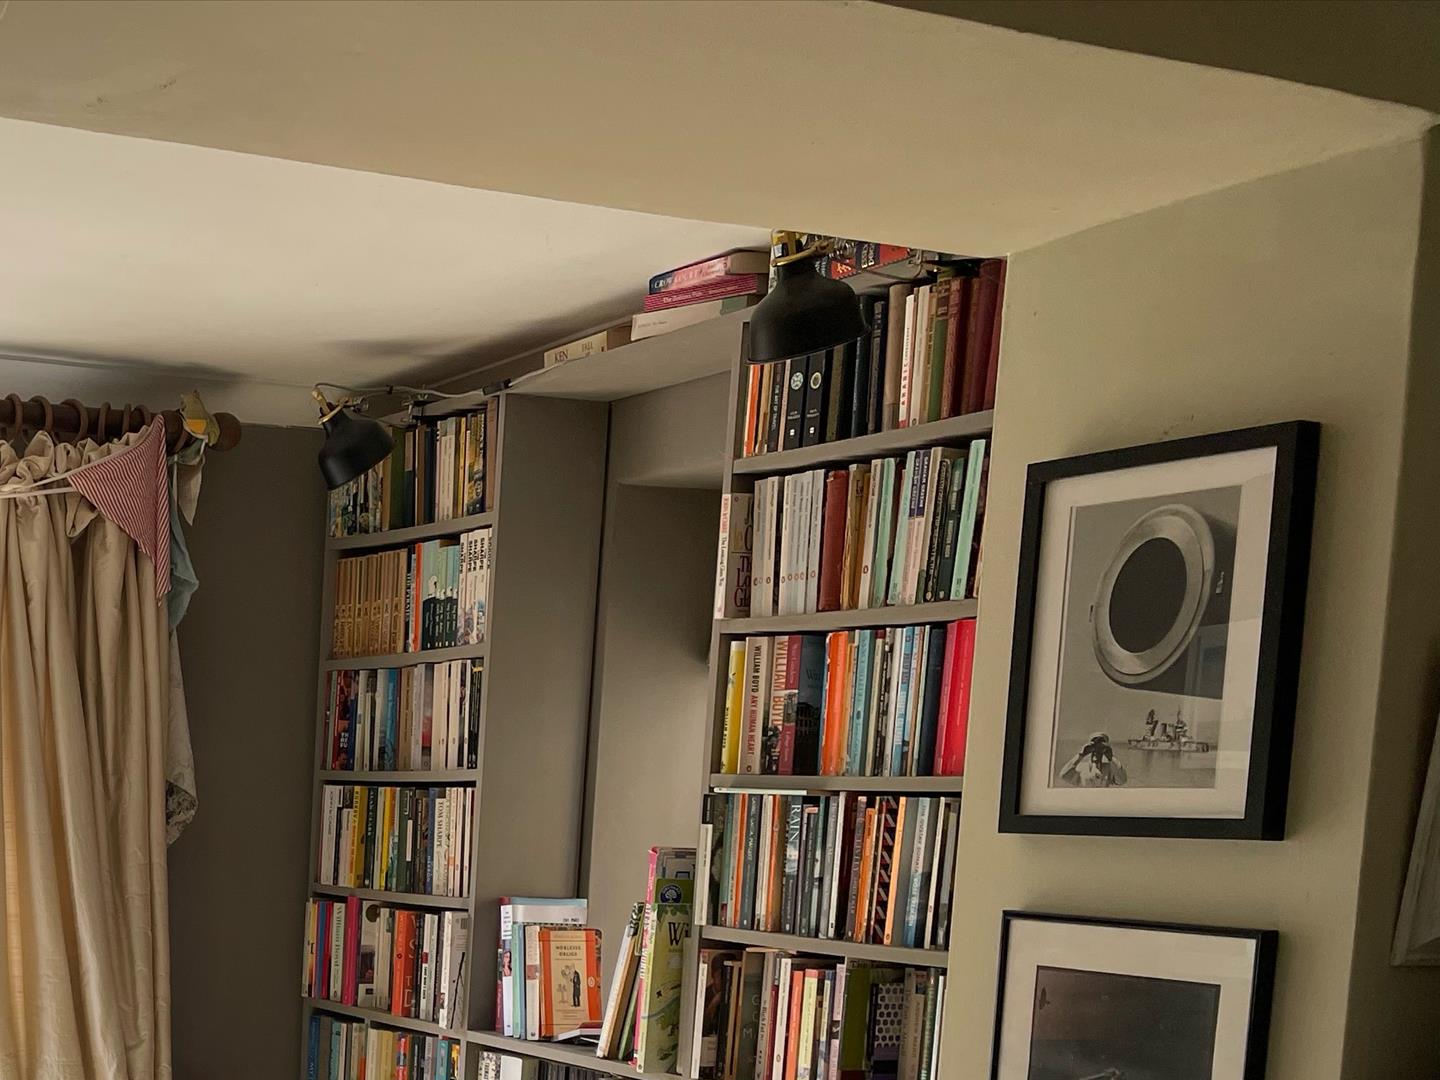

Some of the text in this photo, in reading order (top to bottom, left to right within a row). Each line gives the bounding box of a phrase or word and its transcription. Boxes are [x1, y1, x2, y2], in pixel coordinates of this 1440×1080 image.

[753, 645, 762, 673] WILLIAM
[752, 675, 760, 692] BOYD
[772, 641, 788, 726] WILLIAM BOYD
[749, 709, 757, 733] HUMAN
[747, 734, 756, 755] HEART
[789, 804, 801, 842] RAIN
[334, 906, 343, 967] William Boyd
